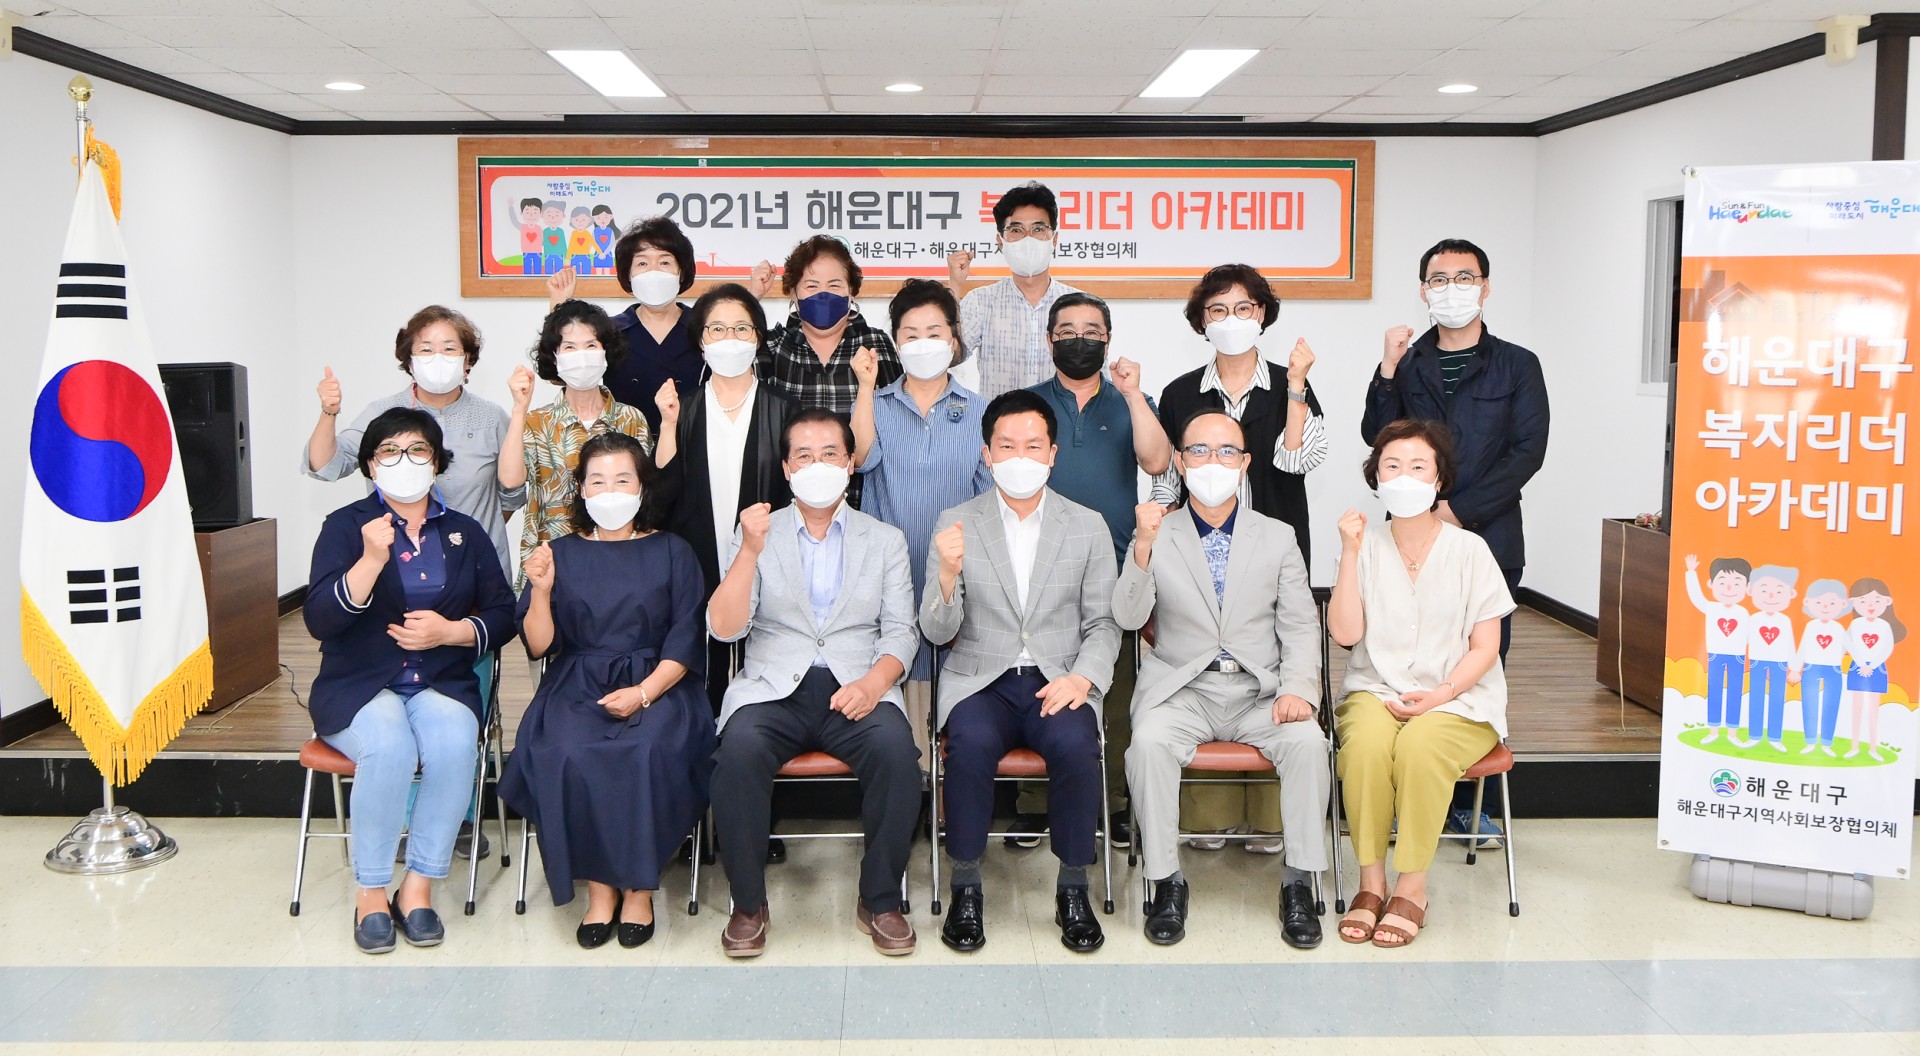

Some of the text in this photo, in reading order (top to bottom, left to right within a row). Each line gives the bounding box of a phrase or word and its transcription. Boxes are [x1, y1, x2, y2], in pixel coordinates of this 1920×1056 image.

[573, 180, 611, 197] 해운대
[1722, 201, 1739, 210] Sun
[1748, 201, 1765, 210] Fun
[1864, 197, 1920, 219] 해운대
[656, 189, 1304, 231] 2021년 해운대구 리더 아카데미
[1709, 204, 1793, 224] Haeundae
[1702, 335, 1914, 389] 해운대구
[1698, 409, 1907, 465] 복지리더
[1695, 477, 1904, 535] 아카데미
[1677, 798, 1898, 839] 해운대구지역사회보장협의체
